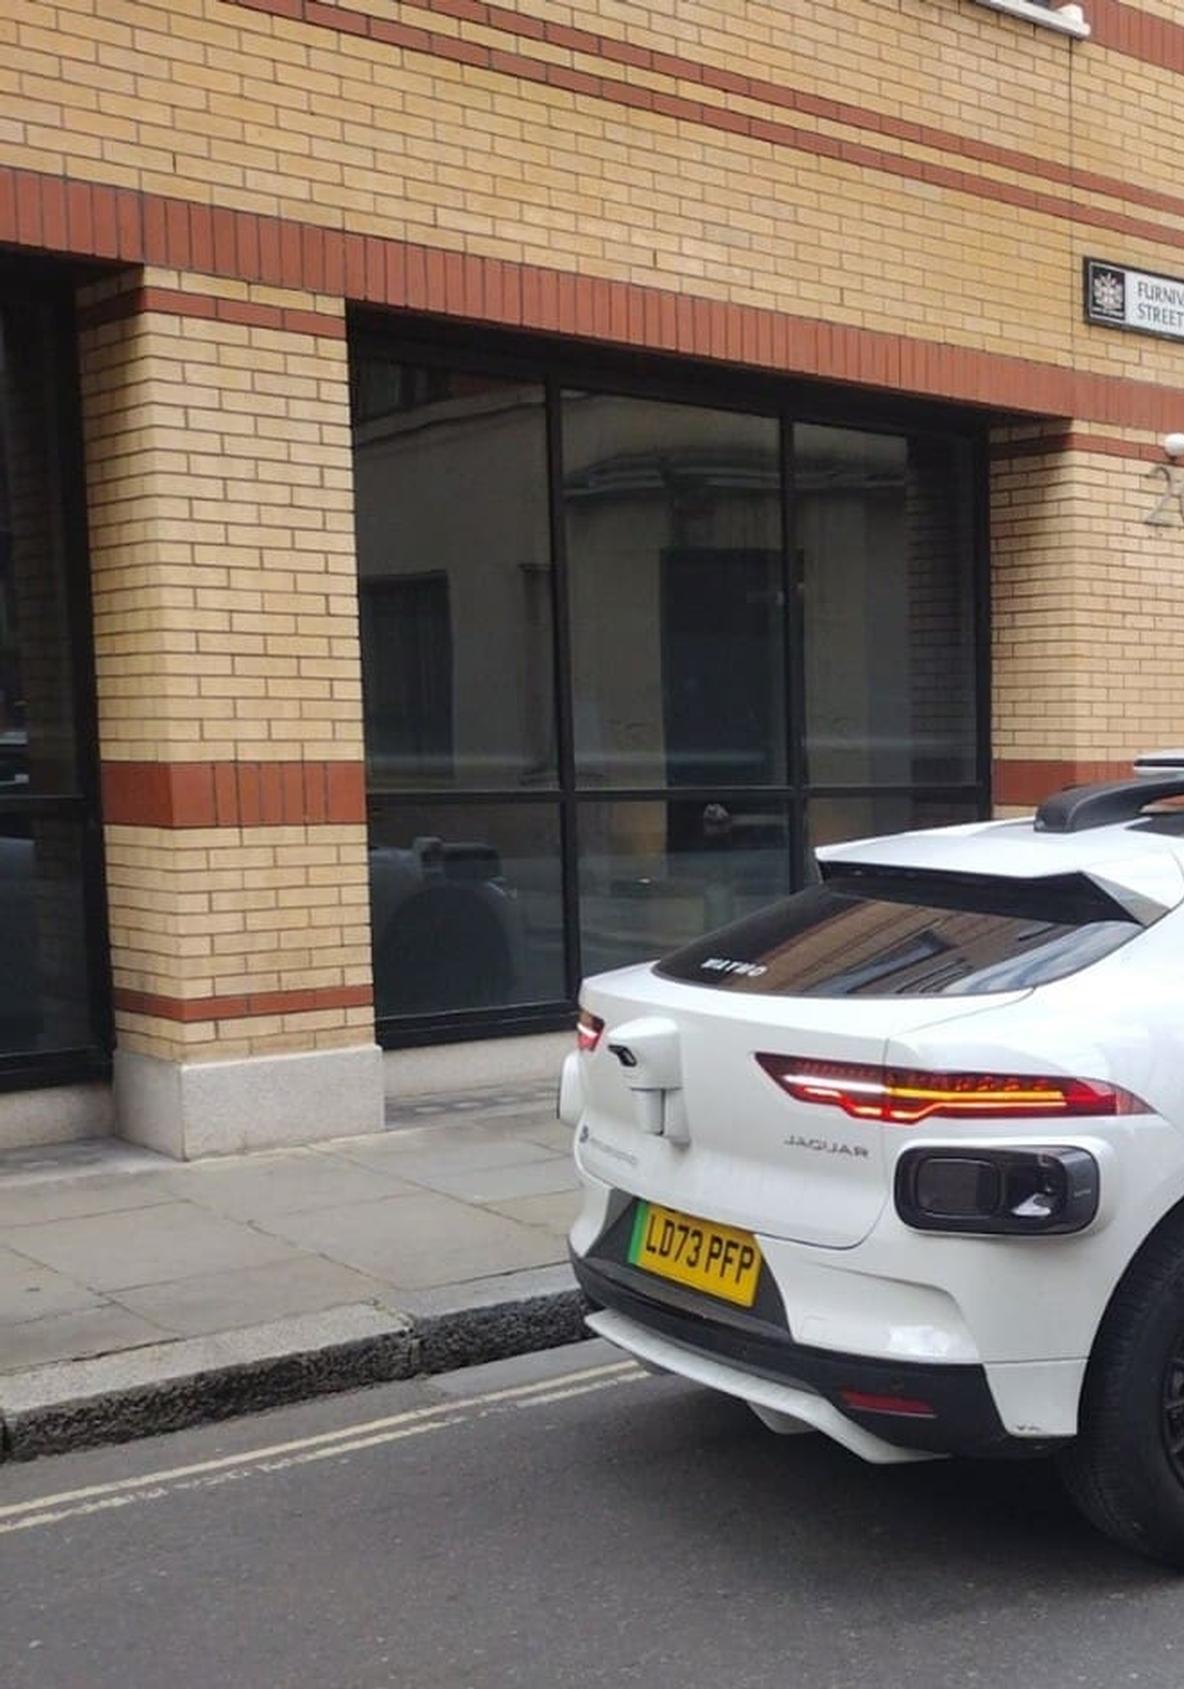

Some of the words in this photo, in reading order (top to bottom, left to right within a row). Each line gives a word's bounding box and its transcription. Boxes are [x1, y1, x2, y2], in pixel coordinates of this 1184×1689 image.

[1138, 303, 1184, 328] STREET
[783, 1135, 869, 1158] JAGUAR
[646, 1214, 704, 1268] LD73
[704, 1234, 756, 1284] PFP
